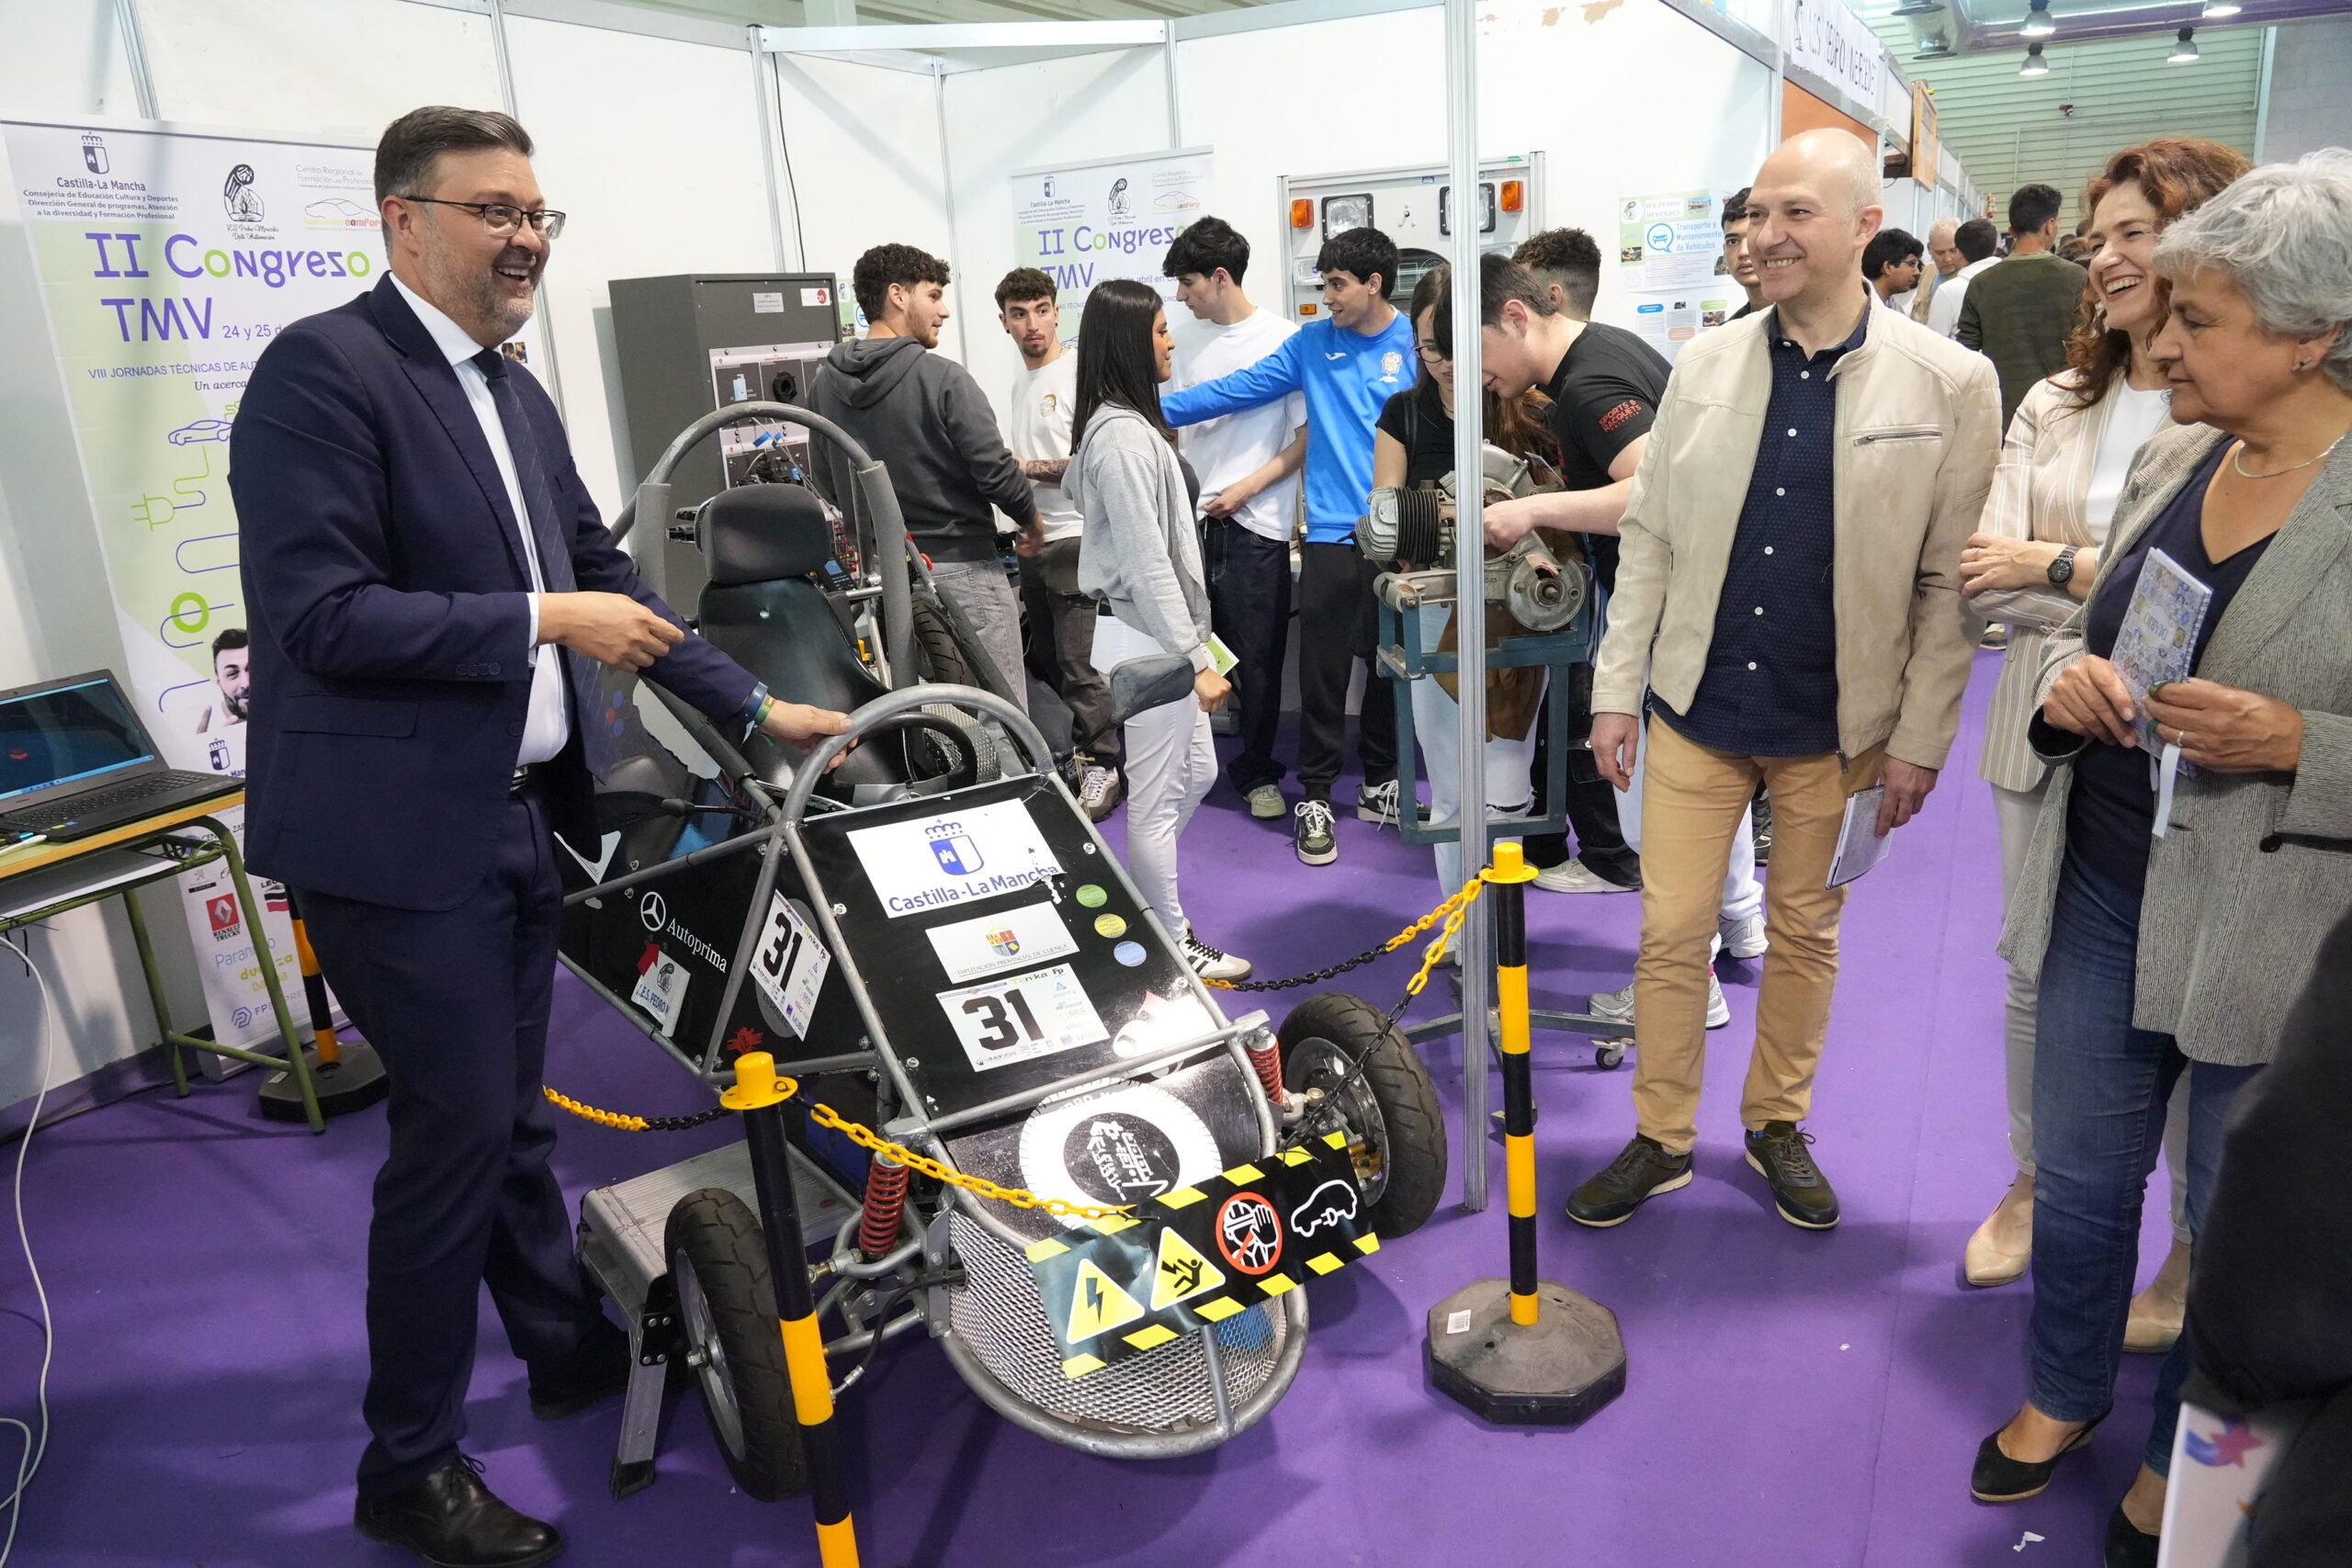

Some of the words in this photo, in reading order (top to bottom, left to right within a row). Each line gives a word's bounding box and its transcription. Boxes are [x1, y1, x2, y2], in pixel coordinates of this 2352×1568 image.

[295, 164, 322, 175] Centro
[322, 166, 355, 176] Regional
[56, 176, 108, 190] Castilla-La
[110, 179, 146, 191] Mancha
[343, 175, 375, 186] Profesora
[28, 199, 66, 208] Dirección
[67, 200, 96, 209] General
[115, 193, 141, 201] Cultura
[147, 195, 179, 203] Deportes
[1676, 221, 1711, 231] Transporte
[1038, 229, 1065, 255] II
[1676, 231, 1723, 241] Mantenimiento
[85, 231, 149, 277] II
[1136, 275, 1153, 284] abril
[101, 297, 212, 343] TMV
[222, 325, 240, 339] 24
[243, 327, 252, 341] y
[255, 324, 272, 338] 25
[88, 368, 107, 379] VIII
[110, 365, 168, 378] JORNADAS
[169, 361, 222, 374] TÉCNICAS
[223, 362, 238, 371] DE
[239, 360, 258, 370] AUT
[195, 381, 209, 391] Un
[213, 381, 248, 390] acerca
[1599, 401, 1630, 424] SPORTS
[1601, 404, 1642, 433] RACQUETS
[994, 864, 1059, 893] Mancha
[213, 923, 241, 937] RENAULT
[216, 930, 242, 942] TRUCKS
[666, 917, 729, 974] Autoprima
[763, 910, 803, 993] 31
[956, 958, 997, 976] DIPUTACIÓN
[997, 951, 1034, 965] PROVINCIAL
[1034, 948, 1043, 957] DE
[1043, 943, 1069, 955] CUENCA
[650, 990, 666, 1013] PEDRO
[961, 988, 1046, 1052] 31
